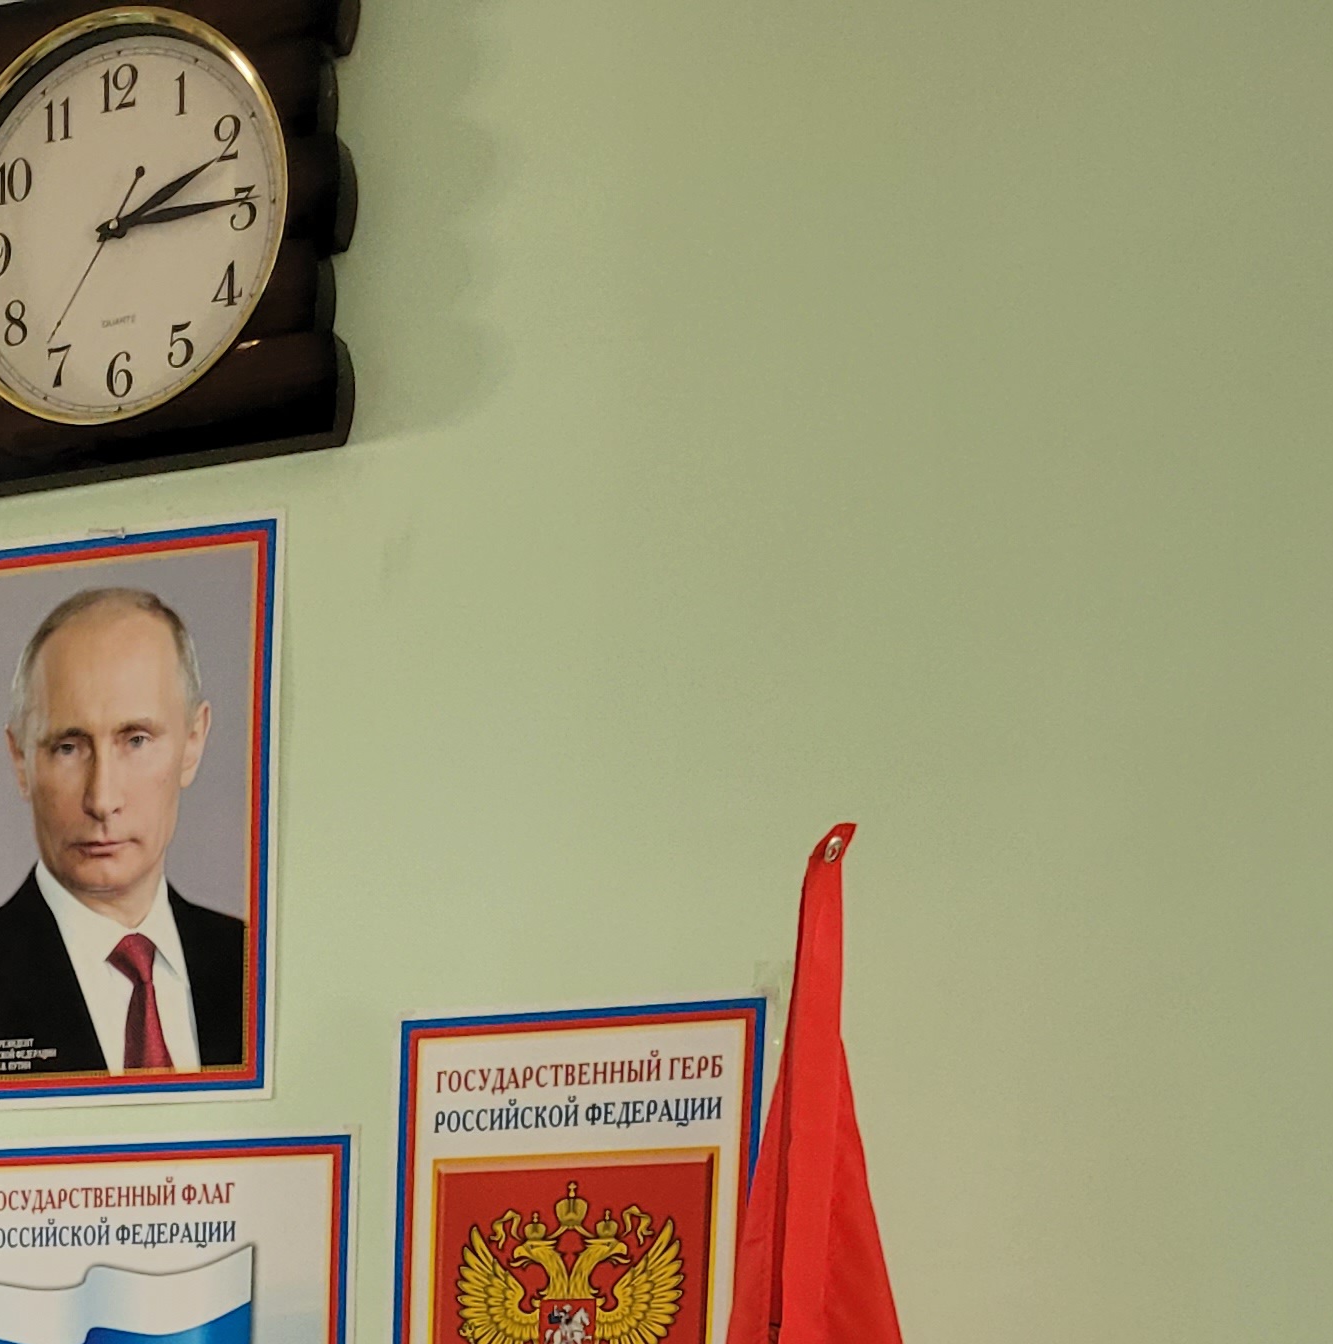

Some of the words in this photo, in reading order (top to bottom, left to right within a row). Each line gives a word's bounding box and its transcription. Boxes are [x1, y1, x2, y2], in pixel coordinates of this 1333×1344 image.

[100, 64, 138, 113] 12
[175, 71, 186, 115] 1
[45, 97, 72, 142] 11
[214, 115, 241, 162] 2
[230, 185, 256, 230] 3
[211, 261, 242, 307] 4
[4, 300, 27, 346] 8
[168, 321, 193, 368] 5
[48, 345, 71, 388] 7
[106, 351, 133, 398] 6
[436, 1050, 662, 1094] ГОСУДАРСТВЕННЫЙ
[668, 1055, 723, 1080] ГЕРБ
[434, 1096, 579, 1133] РОССИЙСКОЙ
[585, 1096, 722, 1128] ФЕДЕРАЦИИ
[182, 1182, 235, 1205] ФЛАГ
[116, 1220, 236, 1248] ФЕДЕРАЦИИ
